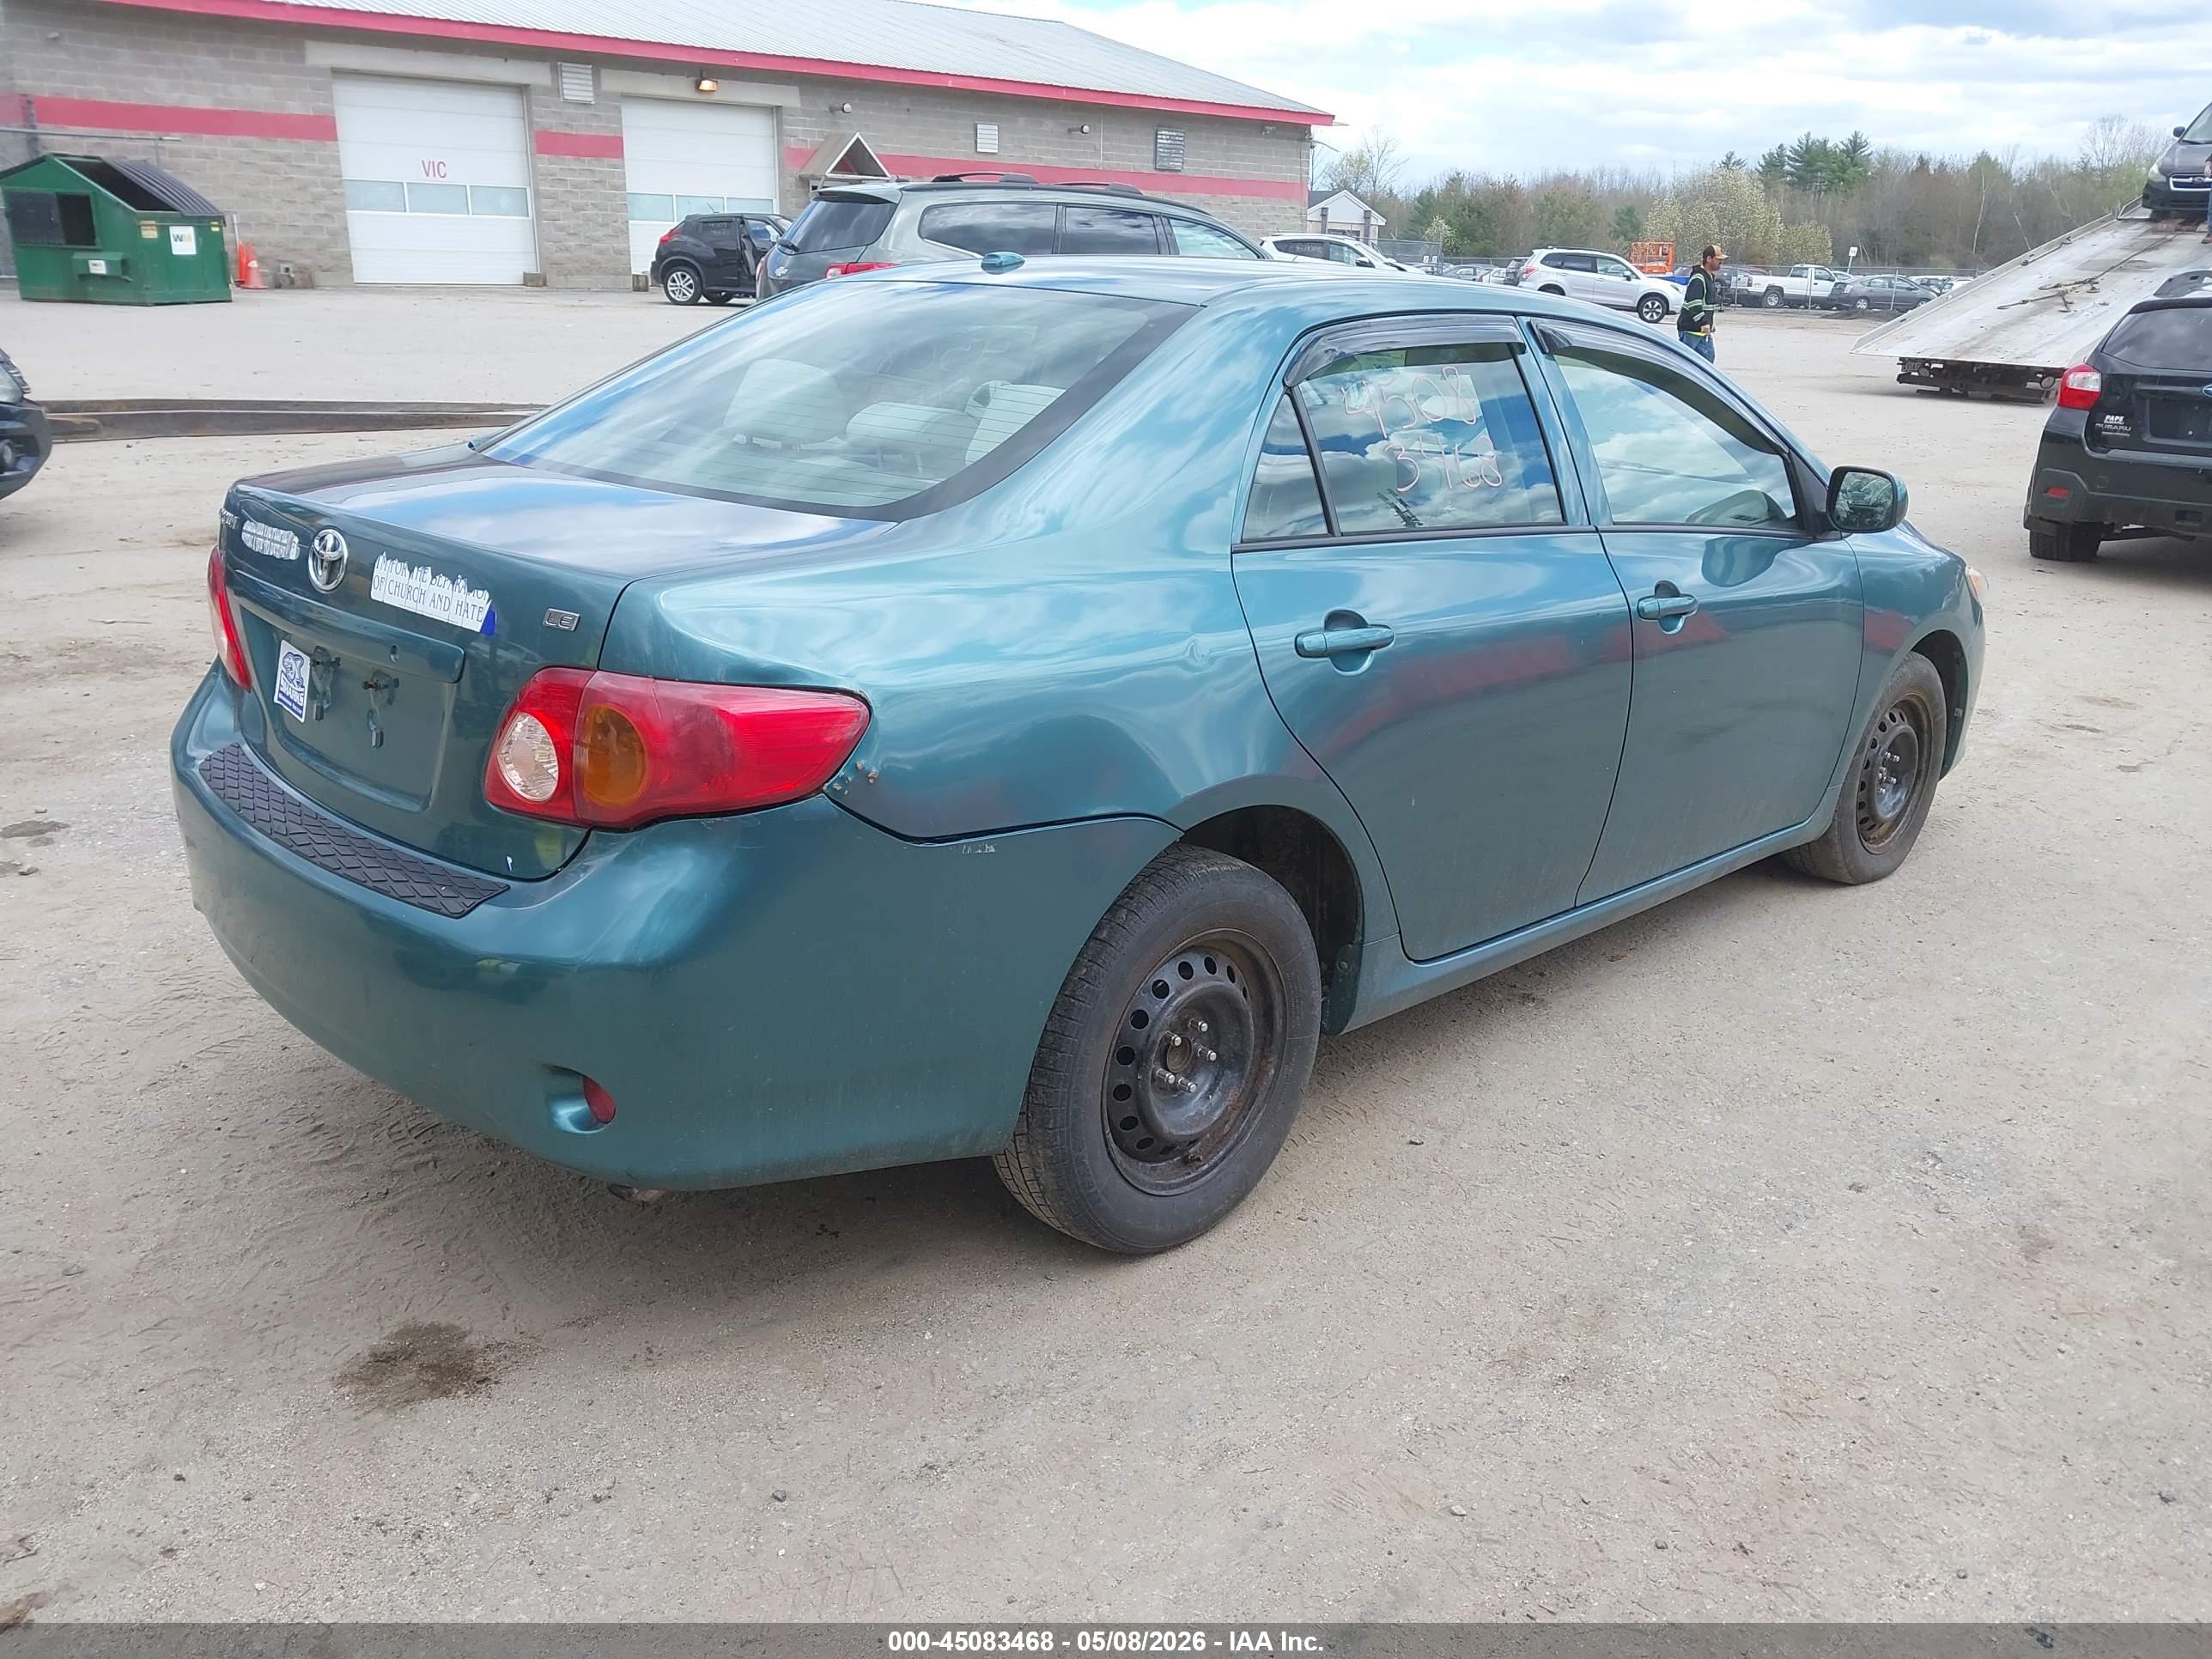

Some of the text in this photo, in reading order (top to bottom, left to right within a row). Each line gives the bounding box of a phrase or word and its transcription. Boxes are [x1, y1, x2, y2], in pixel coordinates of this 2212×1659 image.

[421, 160, 447, 178] VIC
[1340, 367, 1477, 440] 4508
[1385, 435, 1503, 492] 3468
[374, 574, 484, 623] OF CHURCH AND HATE
[545, 610, 574, 629] LE
